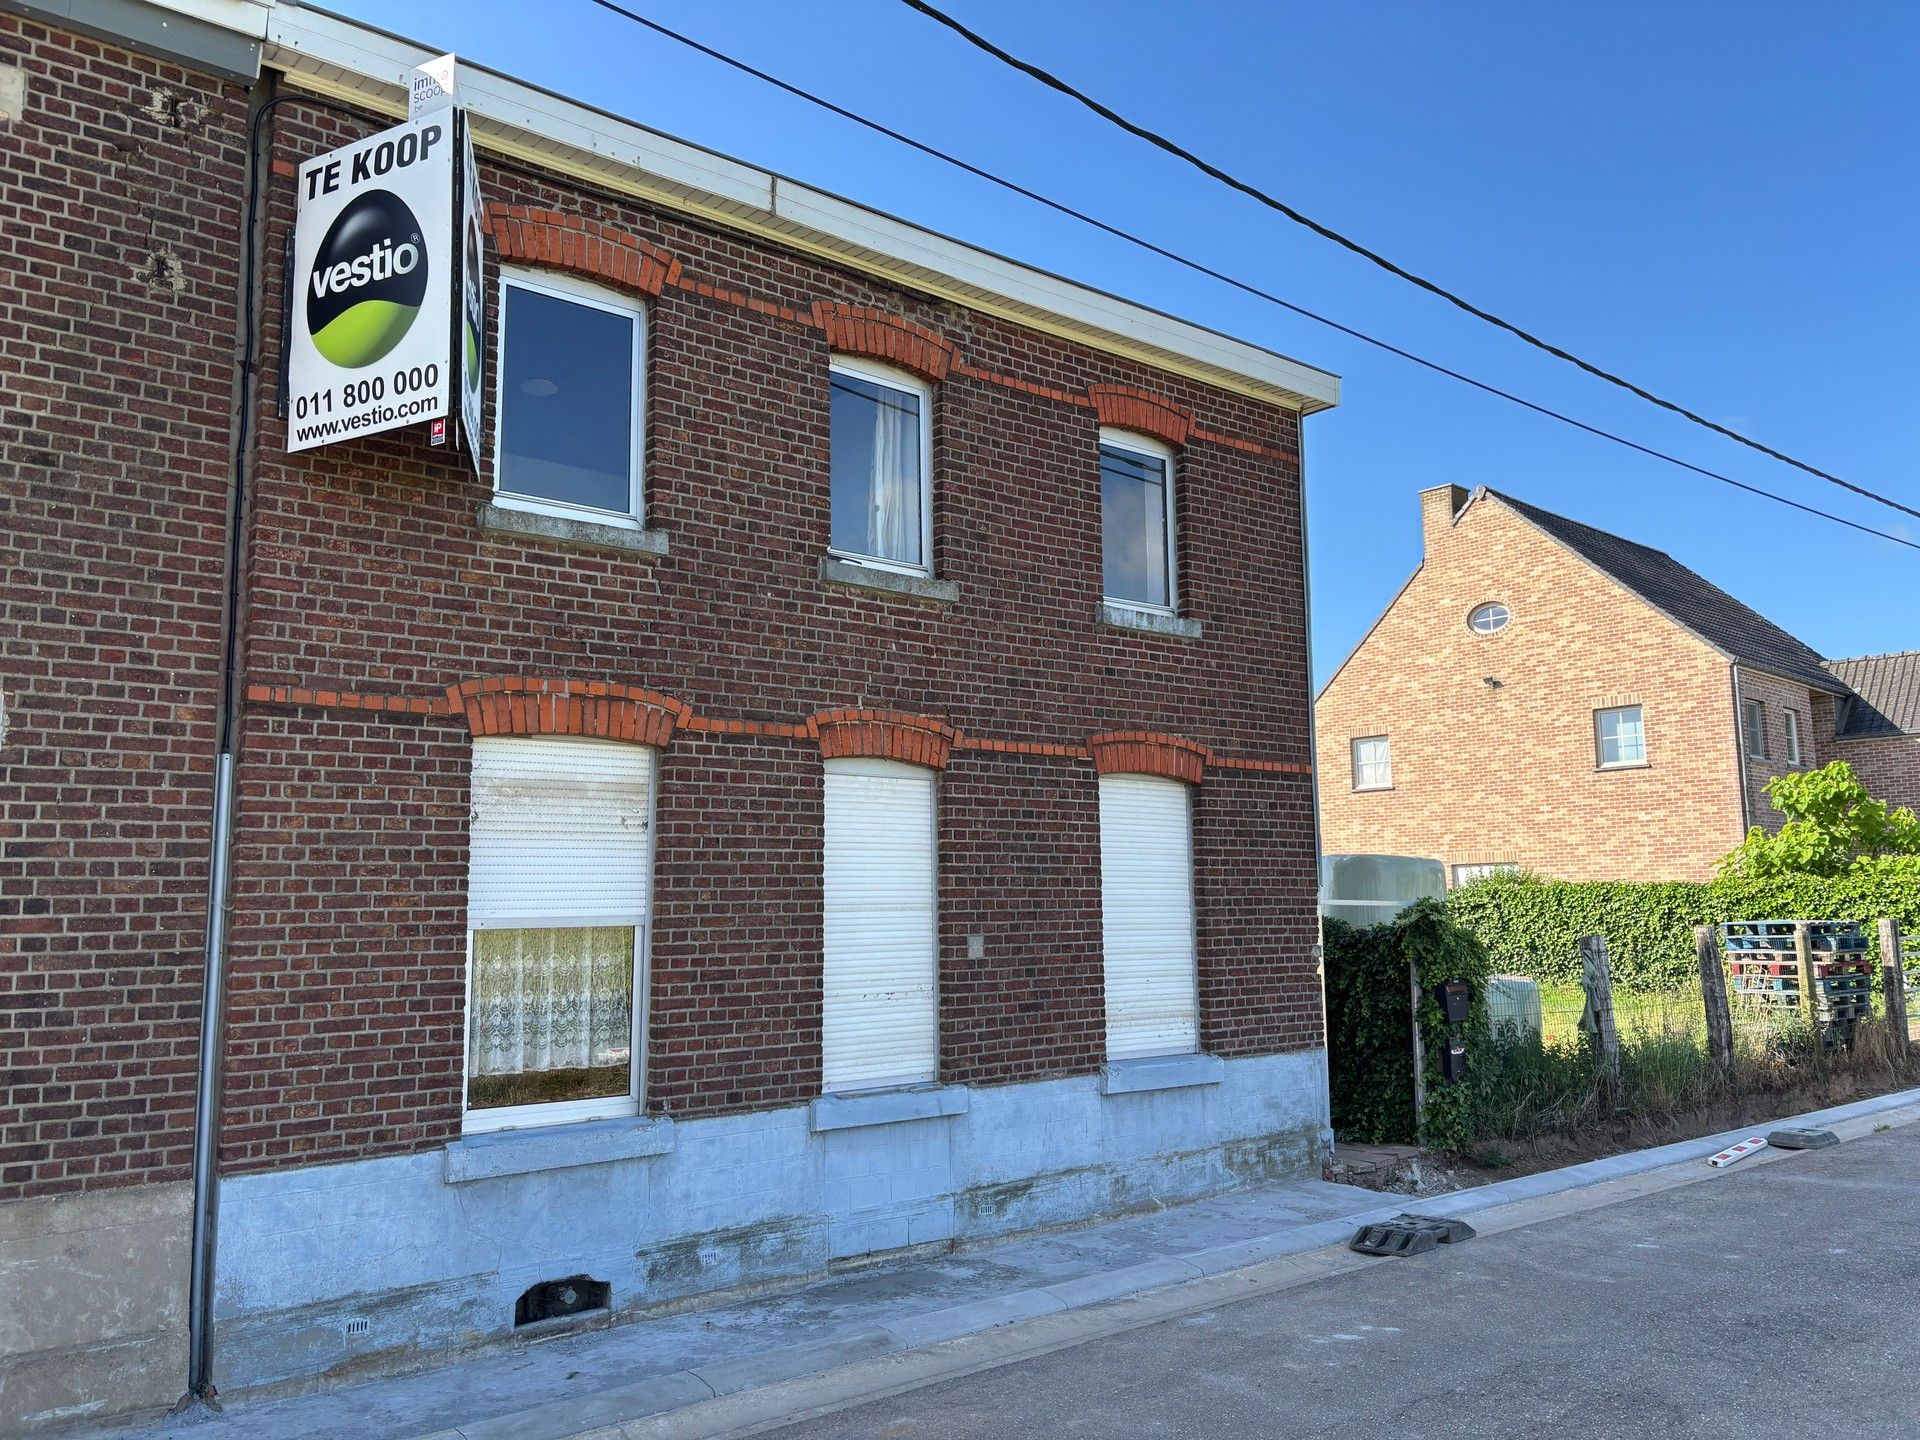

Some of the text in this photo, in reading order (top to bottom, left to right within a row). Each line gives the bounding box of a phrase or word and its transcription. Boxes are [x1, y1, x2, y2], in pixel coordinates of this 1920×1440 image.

[305, 159, 341, 201] TE
[351, 124, 442, 185] KOOP
[312, 237, 419, 299] vestio
[296, 363, 439, 419] 011 800 000
[296, 396, 438, 442] www.vestio.com
